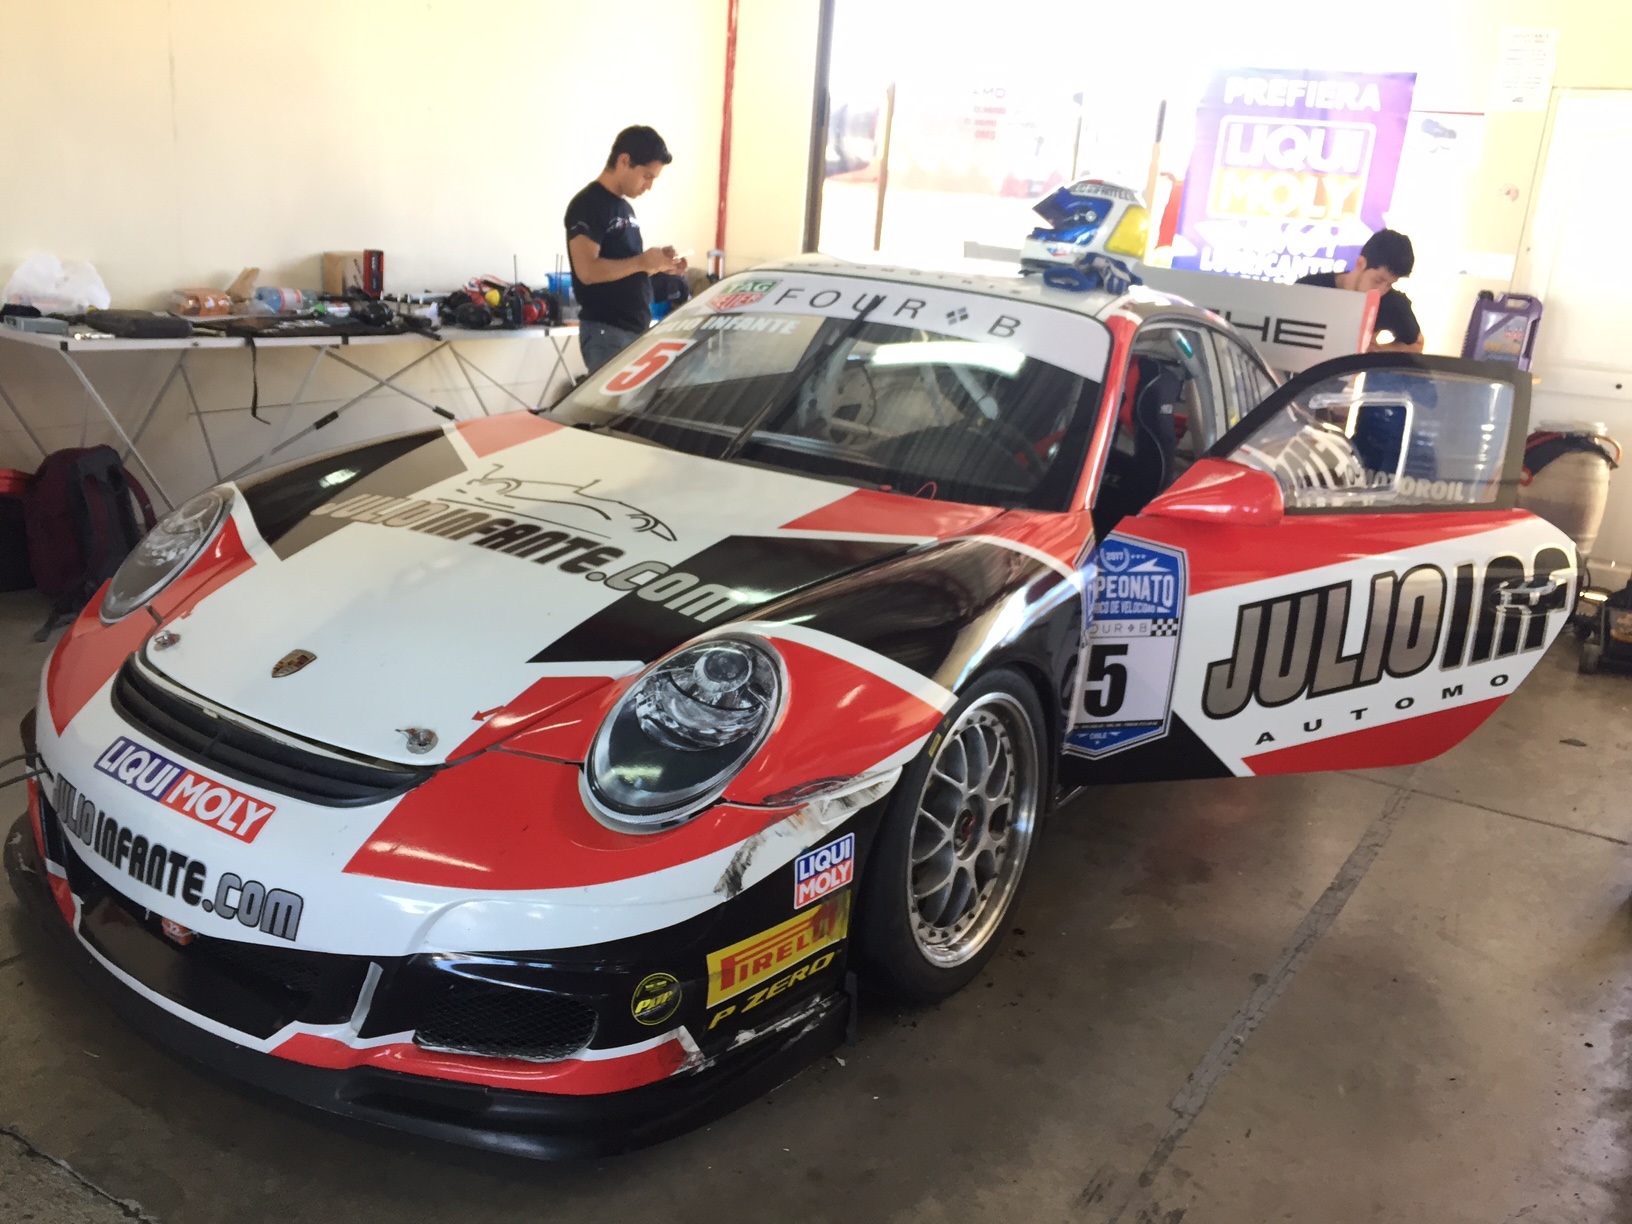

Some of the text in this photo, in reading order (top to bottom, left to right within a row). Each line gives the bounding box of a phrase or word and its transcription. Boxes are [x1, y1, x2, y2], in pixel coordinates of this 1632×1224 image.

[1223, 76, 1381, 112] PREFIERA
[1224, 122, 1367, 173] LIQUI
[1218, 171, 1360, 220] MOLY
[727, 280, 772, 293] TAG
[701, 315, 799, 335] INFANTE
[987, 315, 1021, 338] B
[1208, 309, 1327, 351] HE
[602, 340, 694, 394] 5
[1095, 573, 1175, 608] PEONATO
[1084, 643, 1129, 718] 5
[1254, 673, 1510, 746] AUTOMO
[97, 739, 274, 838] LIQUI MOLY
[799, 838, 851, 880] LIQUI
[797, 862, 852, 907] MOLY
[708, 951, 837, 1030] P ZERO
